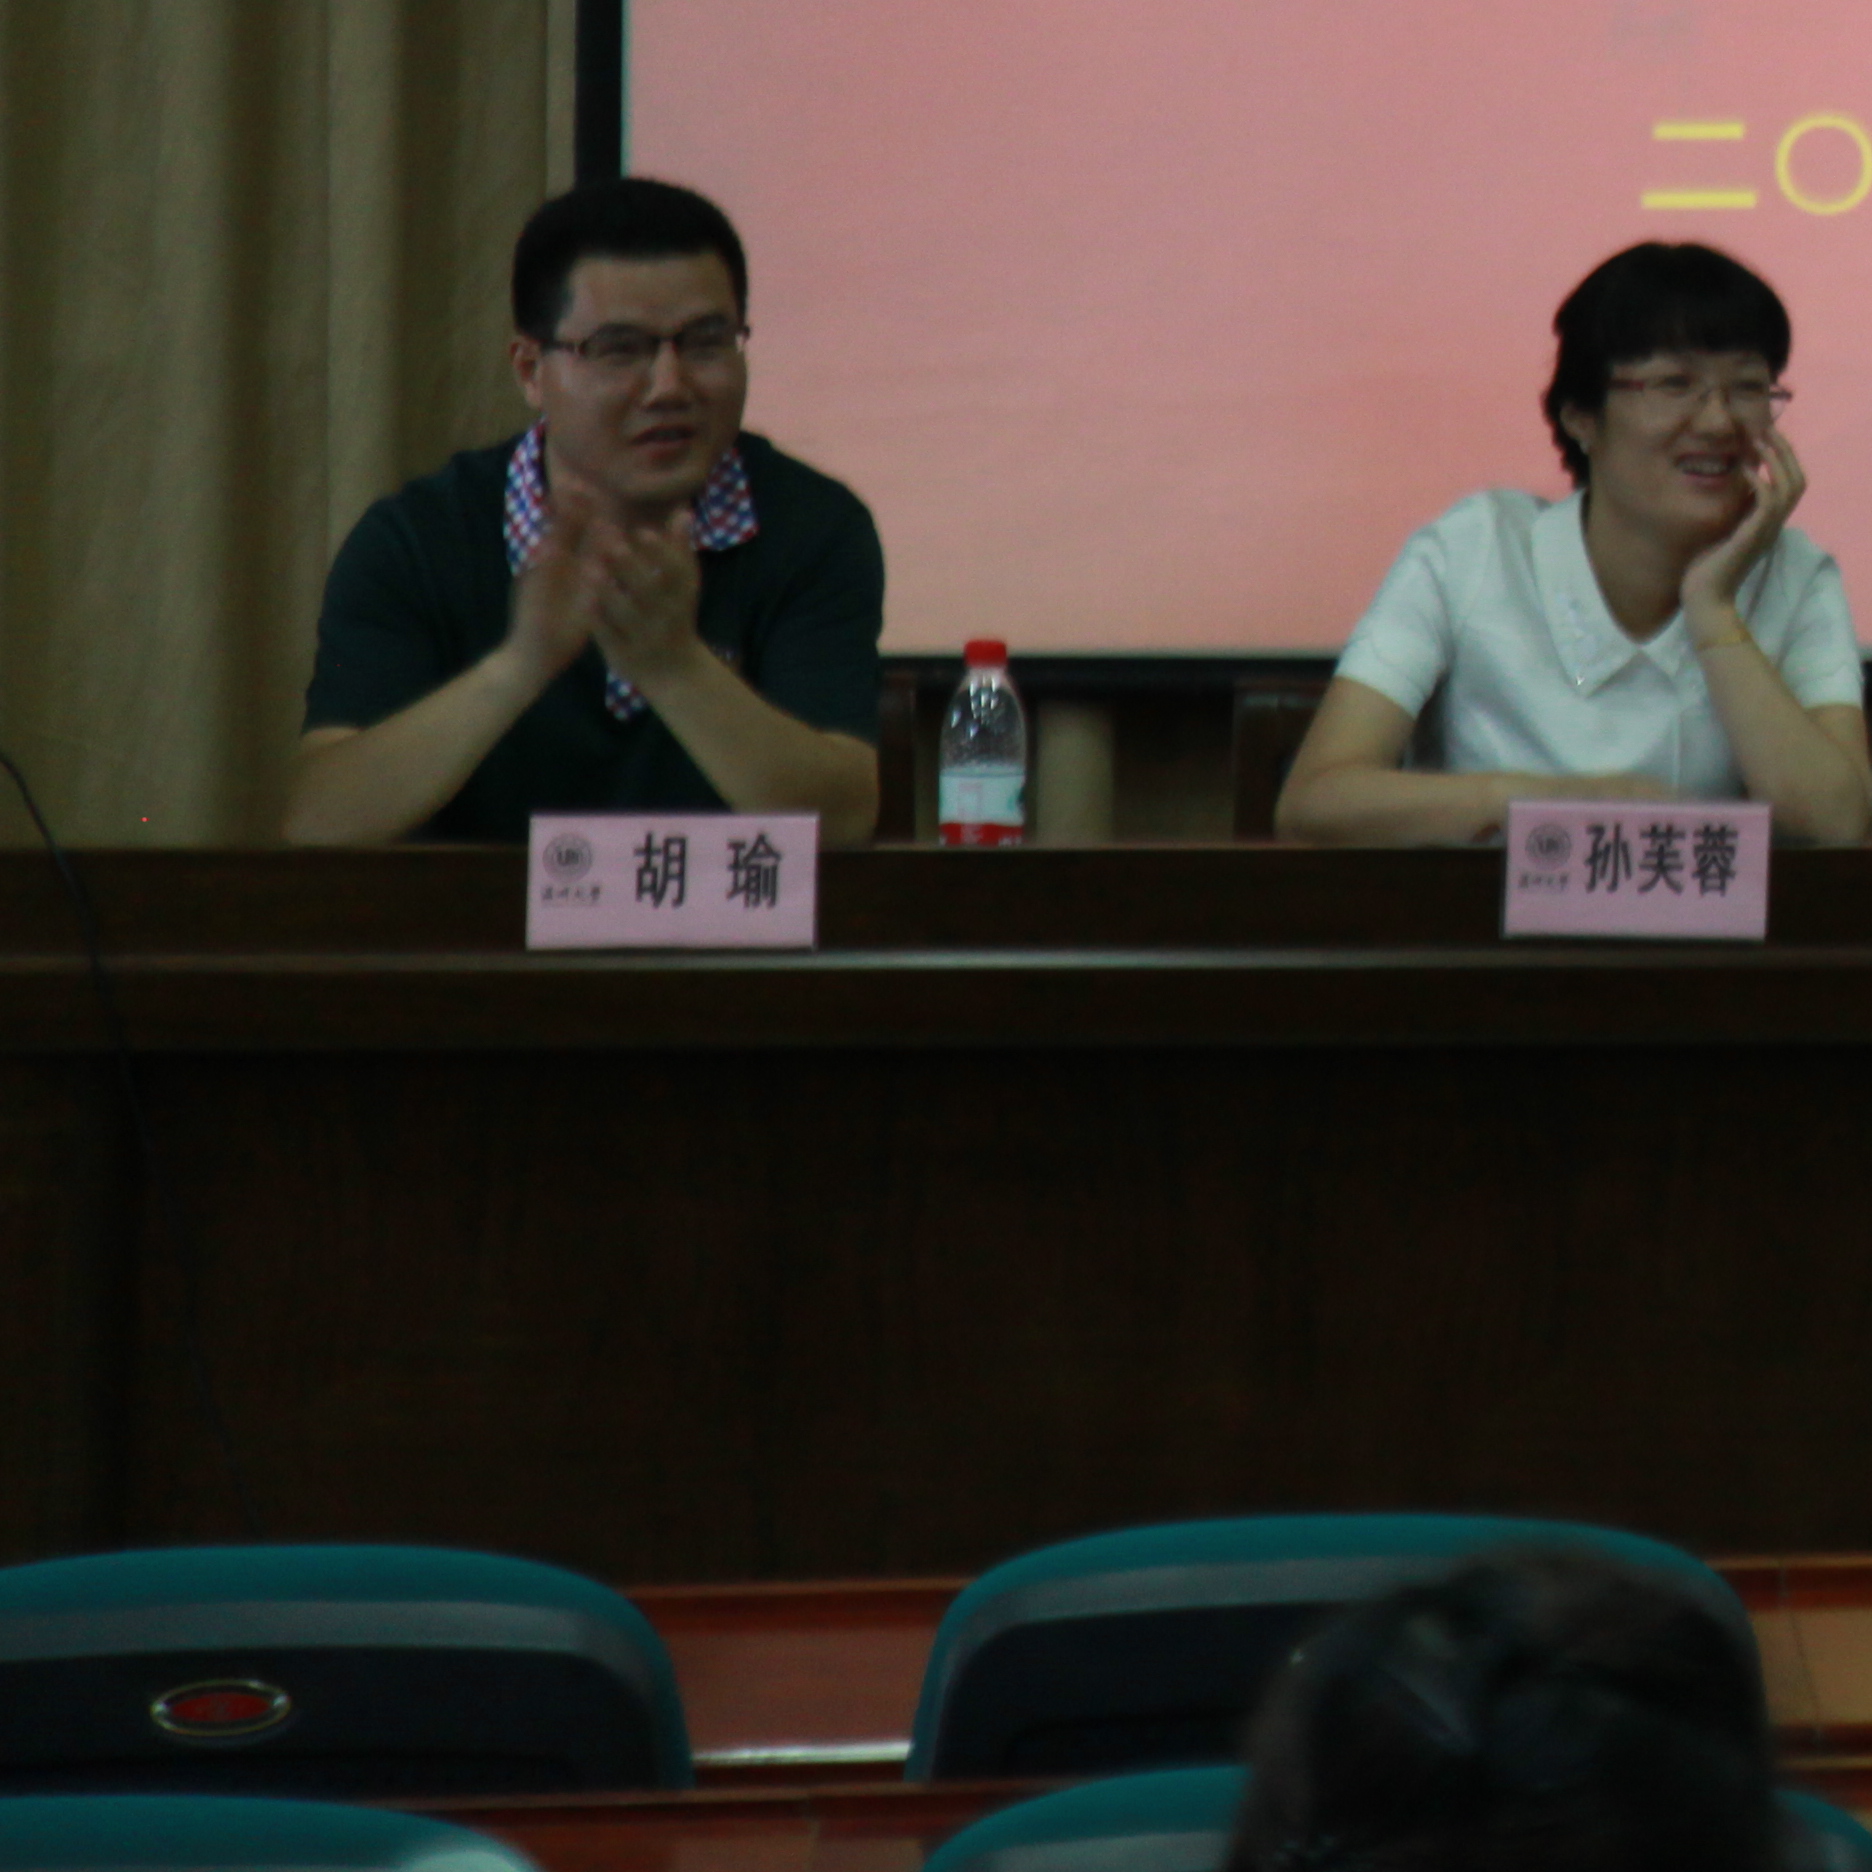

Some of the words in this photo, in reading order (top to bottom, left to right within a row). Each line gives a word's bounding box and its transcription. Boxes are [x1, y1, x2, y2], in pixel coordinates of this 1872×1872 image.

[633, 829, 785, 909] 胡瑜
[1583, 822, 1740, 898] 孙芙蓉
